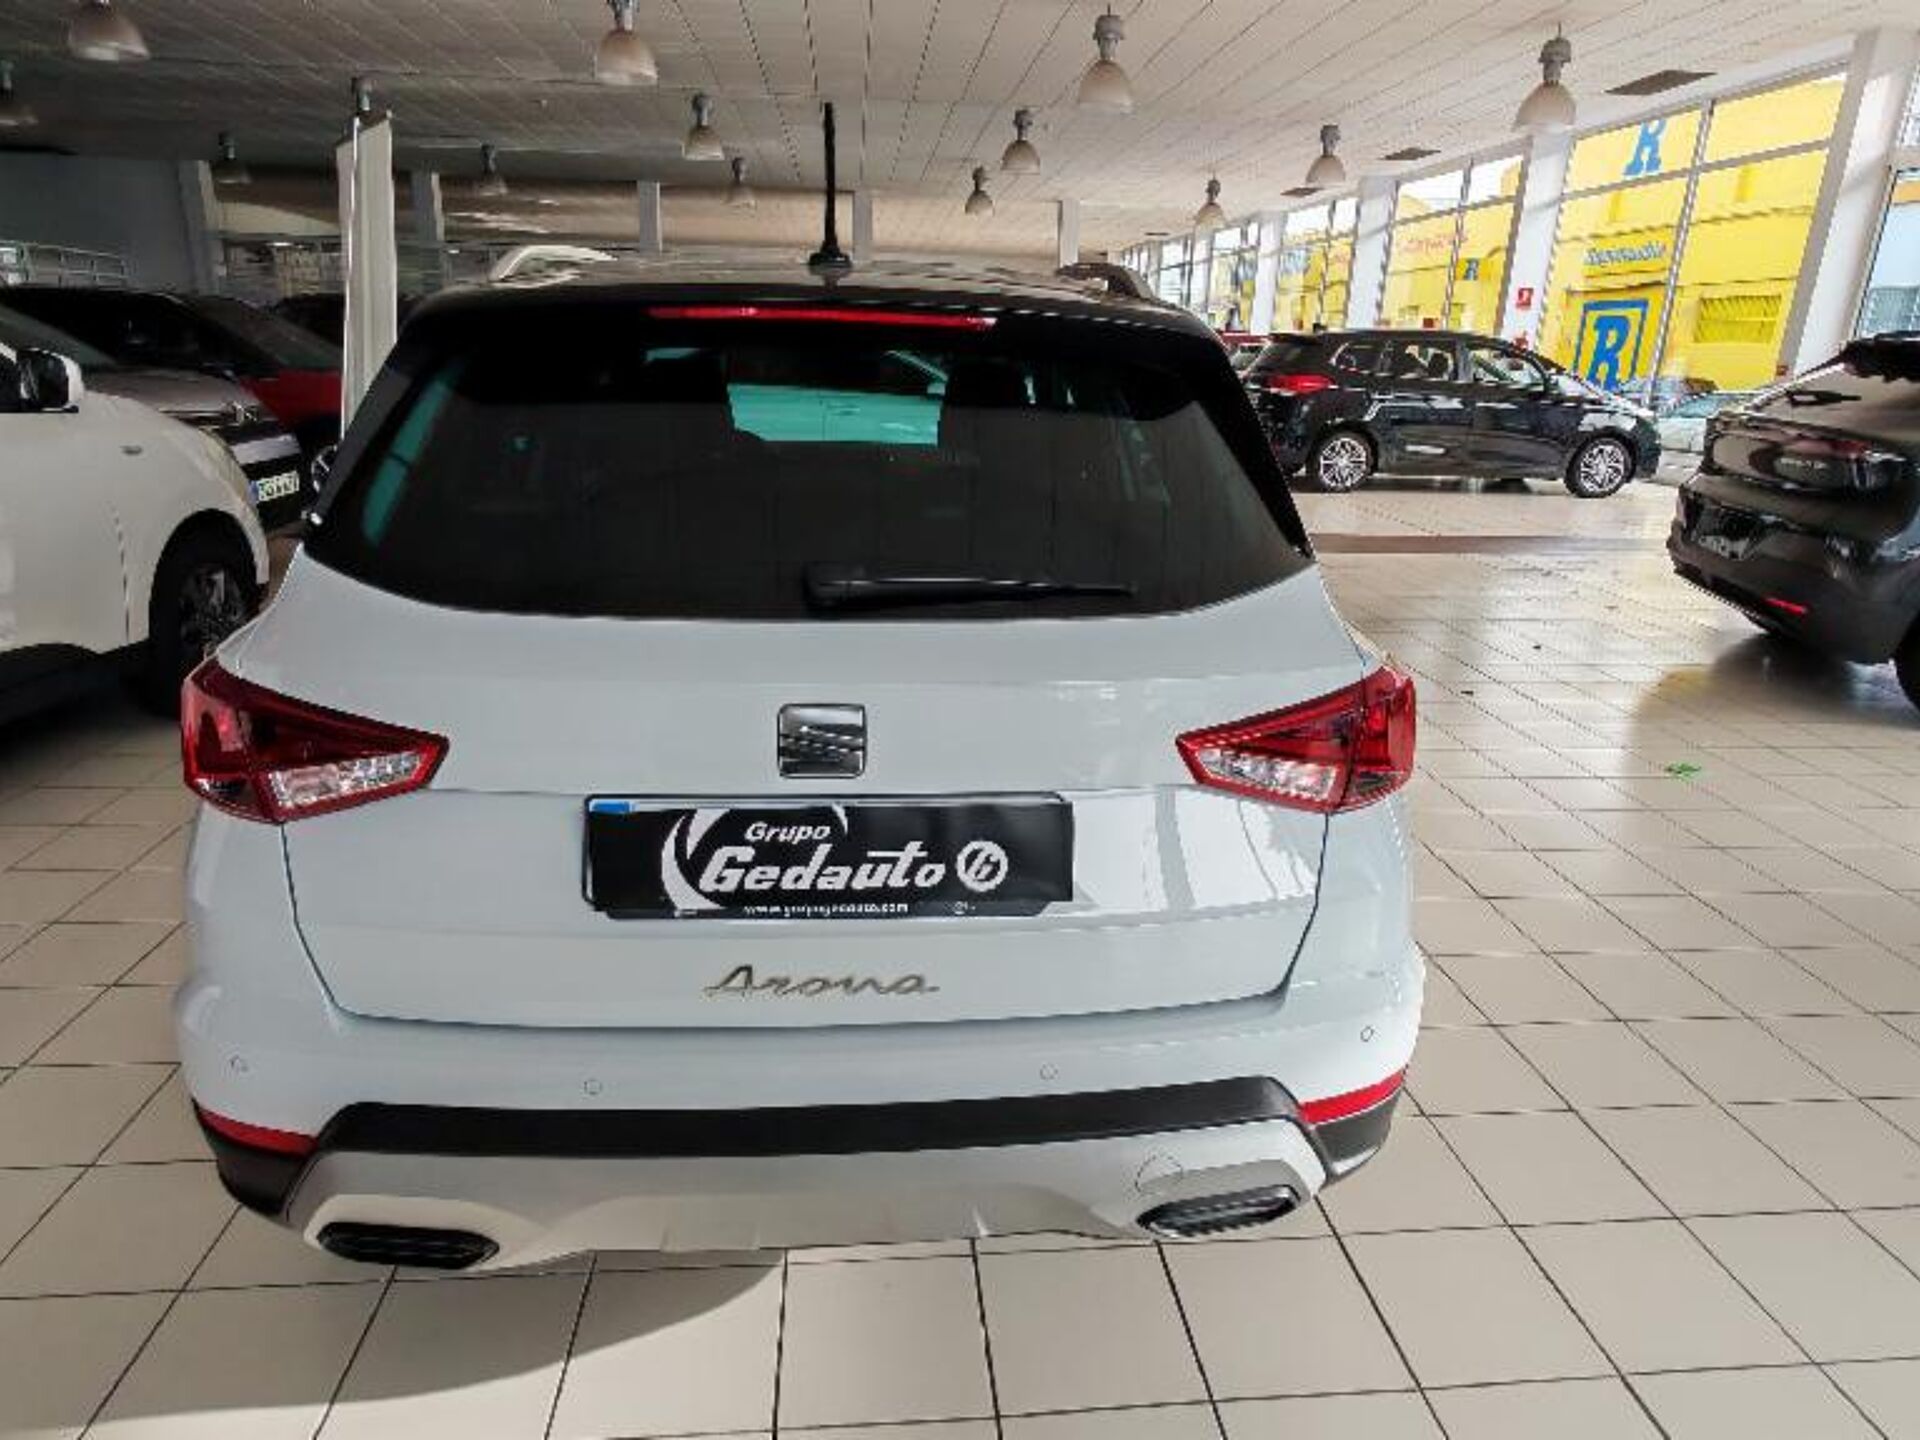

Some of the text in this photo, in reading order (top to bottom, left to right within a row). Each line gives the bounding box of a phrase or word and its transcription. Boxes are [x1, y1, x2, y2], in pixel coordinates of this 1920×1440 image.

[1622, 119, 1667, 176] R
[1586, 315, 1630, 392] R
[744, 821, 831, 845] Grupo
[699, 841, 946, 892] Gedauto
[703, 964, 940, 998] Arona
